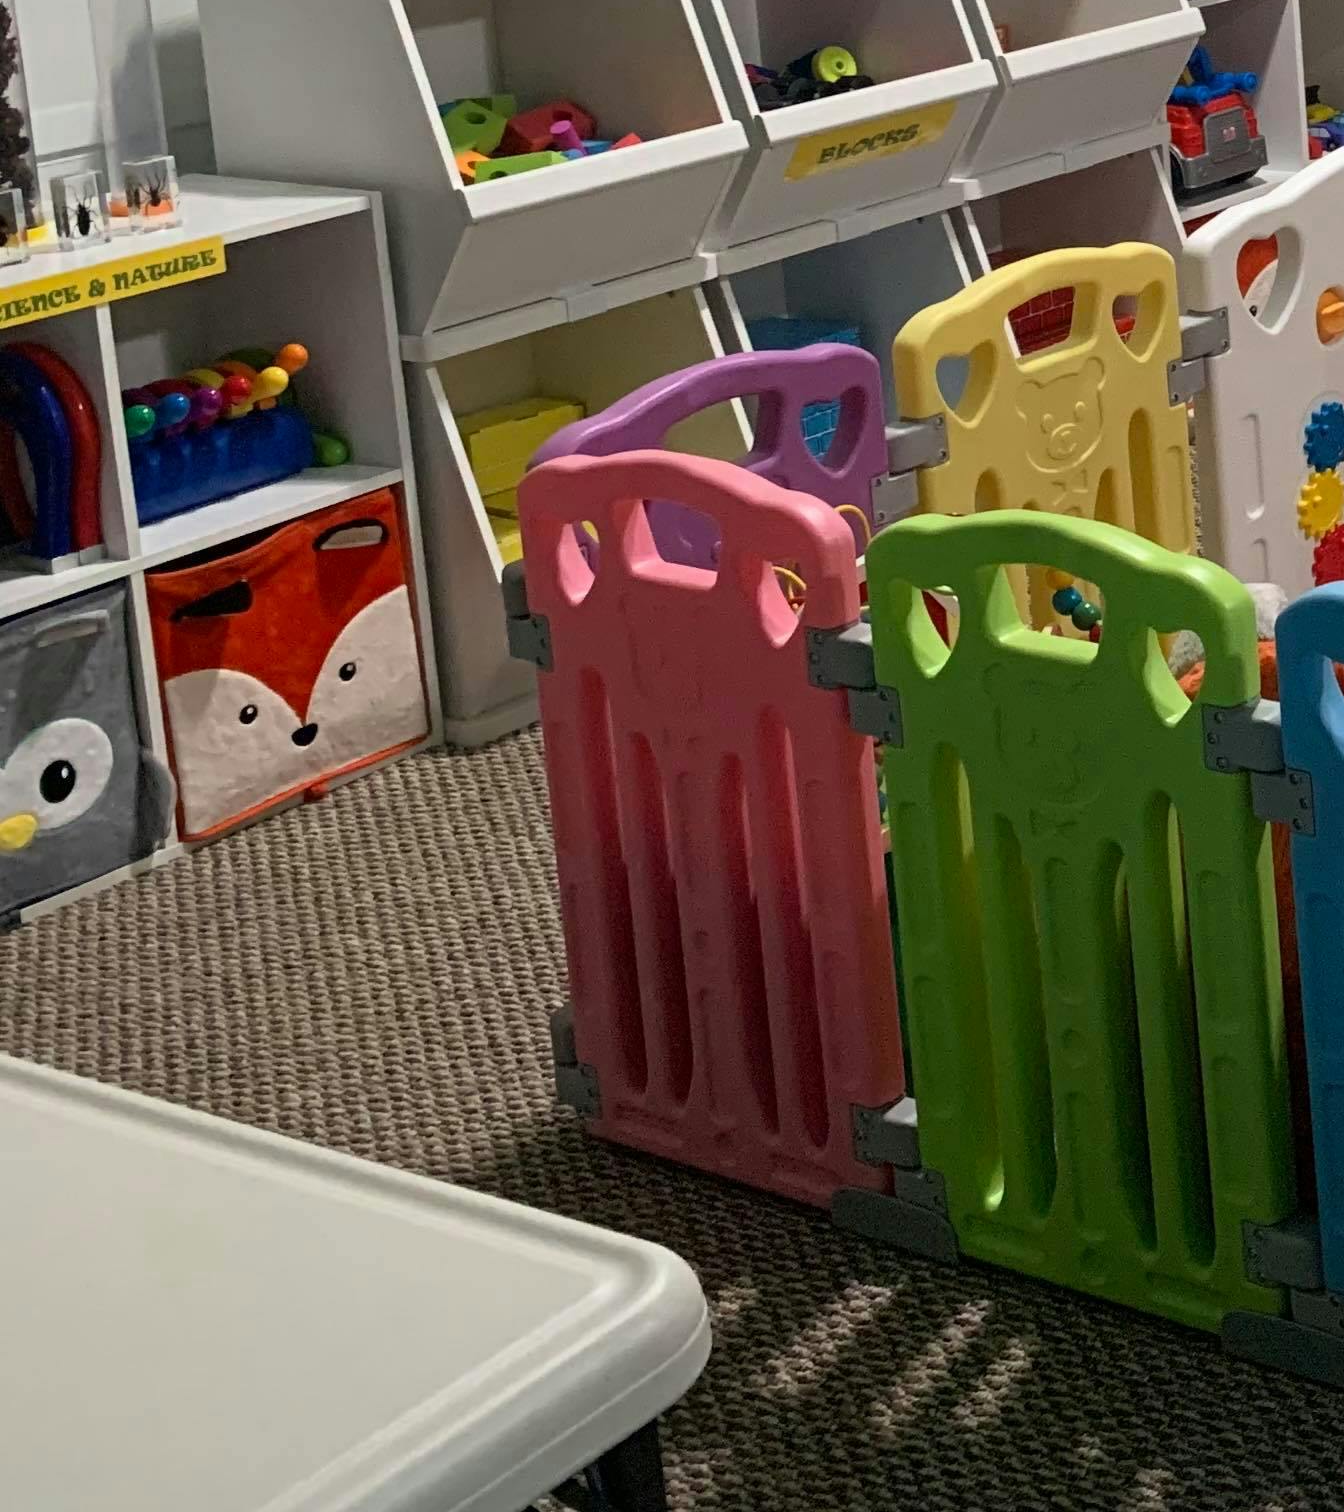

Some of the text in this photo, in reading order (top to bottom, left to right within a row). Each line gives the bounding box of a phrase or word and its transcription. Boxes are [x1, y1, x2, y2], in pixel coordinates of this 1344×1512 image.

[816, 122, 921, 165] BLOCKS
[0, 249, 217, 323] IENCE & NATURE
